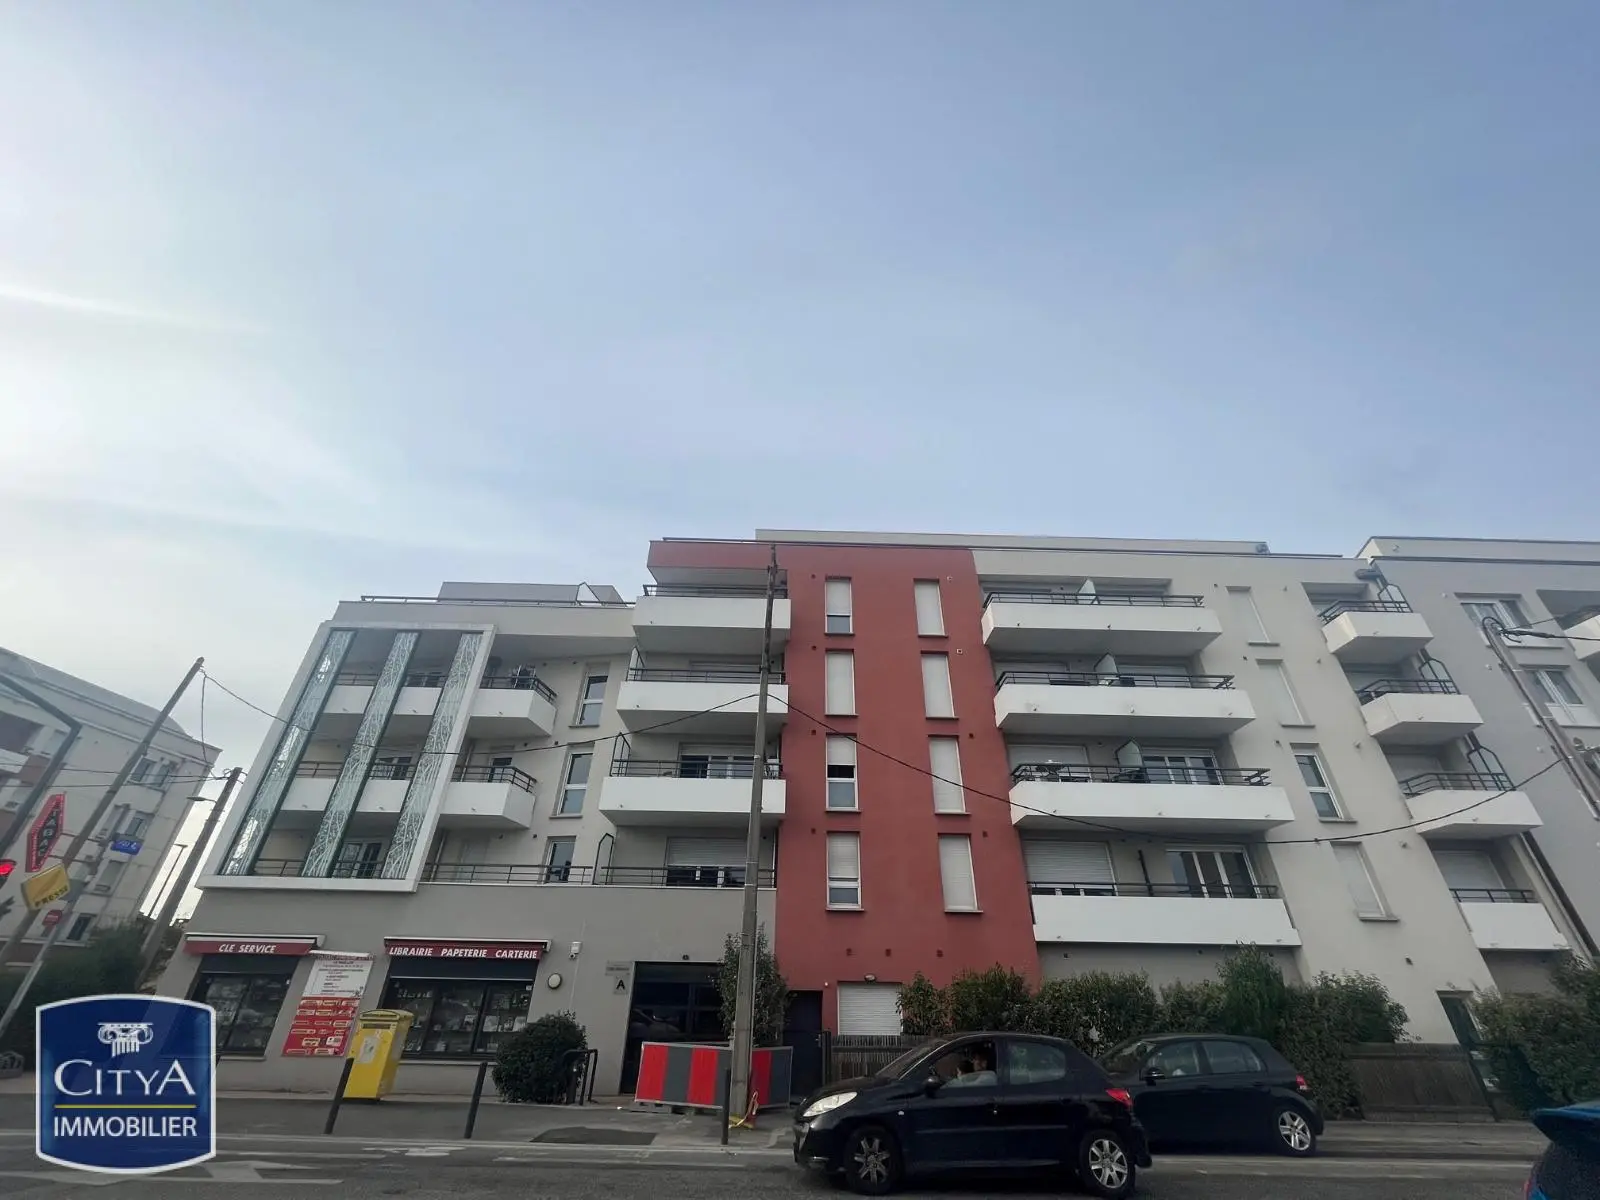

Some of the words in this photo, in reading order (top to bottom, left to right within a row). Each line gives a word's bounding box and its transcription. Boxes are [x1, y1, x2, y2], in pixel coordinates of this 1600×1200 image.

[218, 943, 235, 953] CLE
[238, 944, 277, 954] SERVICE
[388, 946, 433, 956] LIBRAIRIE
[440, 948, 488, 958] PAPETERIE
[495, 949, 538, 959] CARTERIE
[615, 979, 626, 990] A
